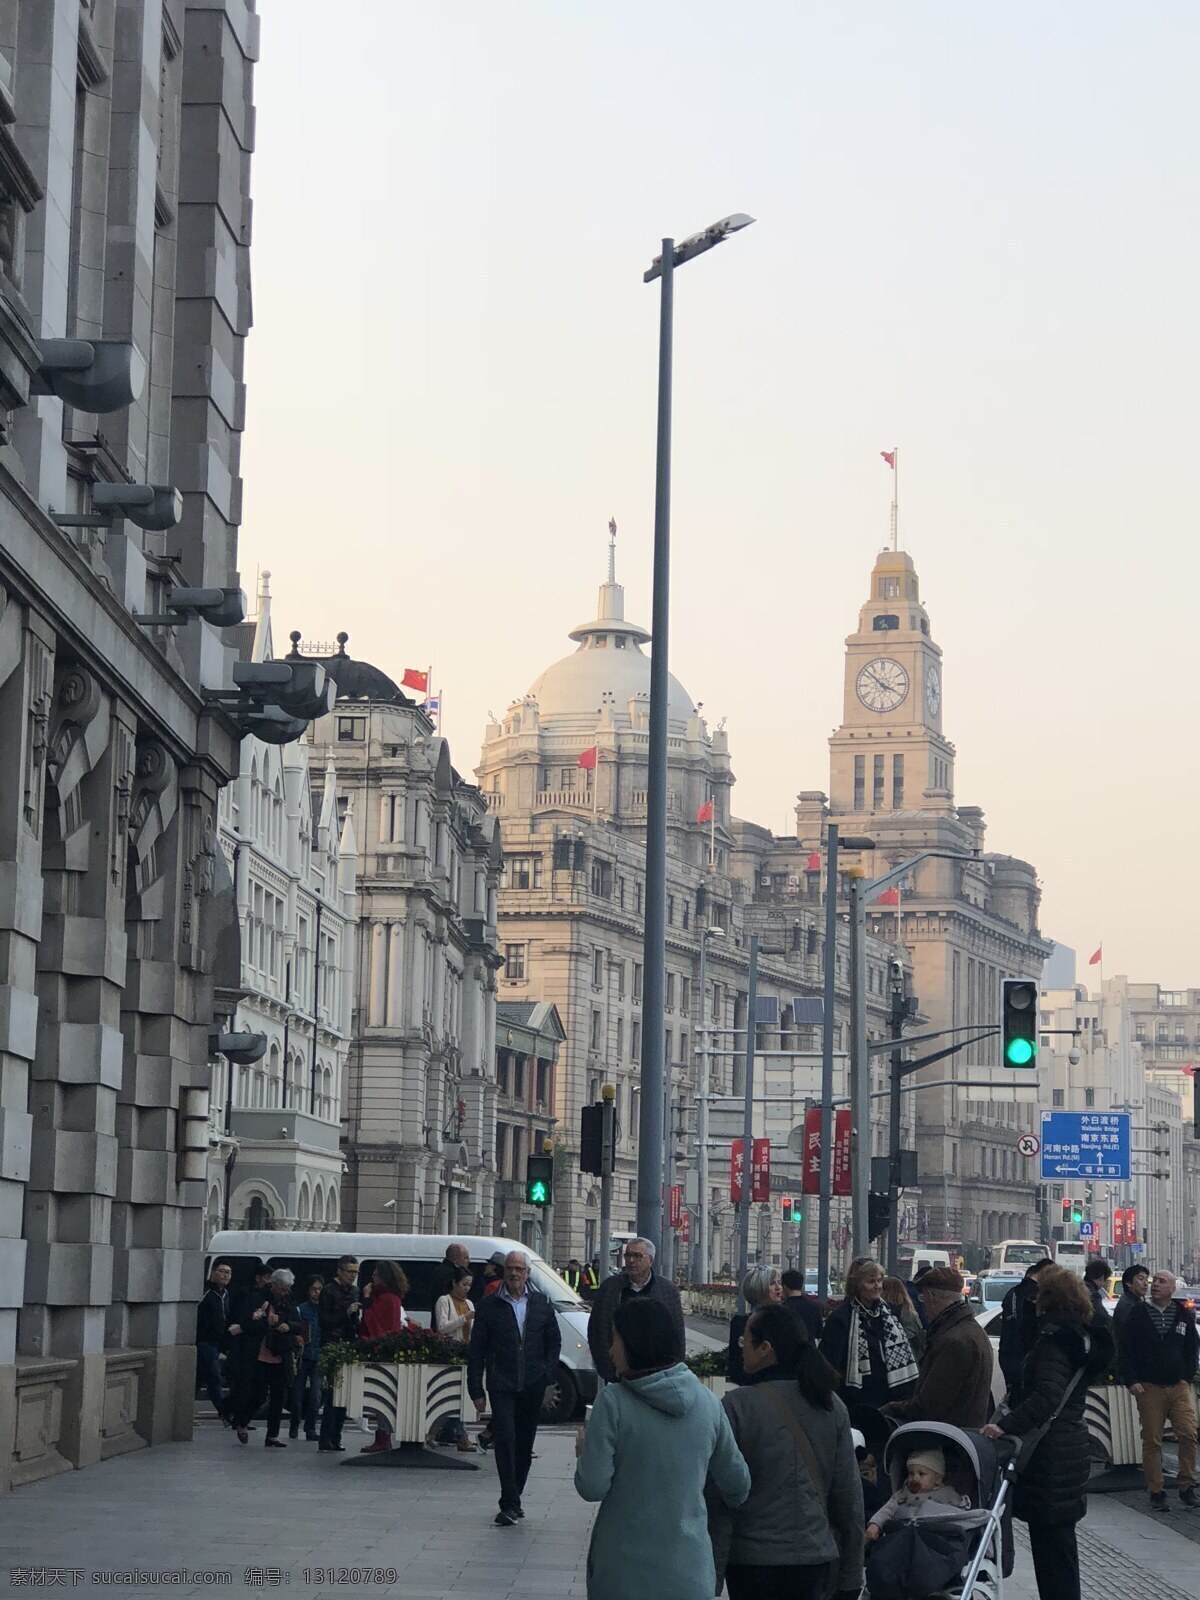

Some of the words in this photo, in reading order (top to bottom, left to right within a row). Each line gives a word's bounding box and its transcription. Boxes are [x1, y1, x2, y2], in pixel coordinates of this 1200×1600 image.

[1081, 1115, 1119, 1125] 外白渡桥
[1081, 1134, 1119, 1143] 南京东路
[1043, 1144, 1080, 1153] 河南中路
[1085, 1166, 1116, 1174] 福州路
